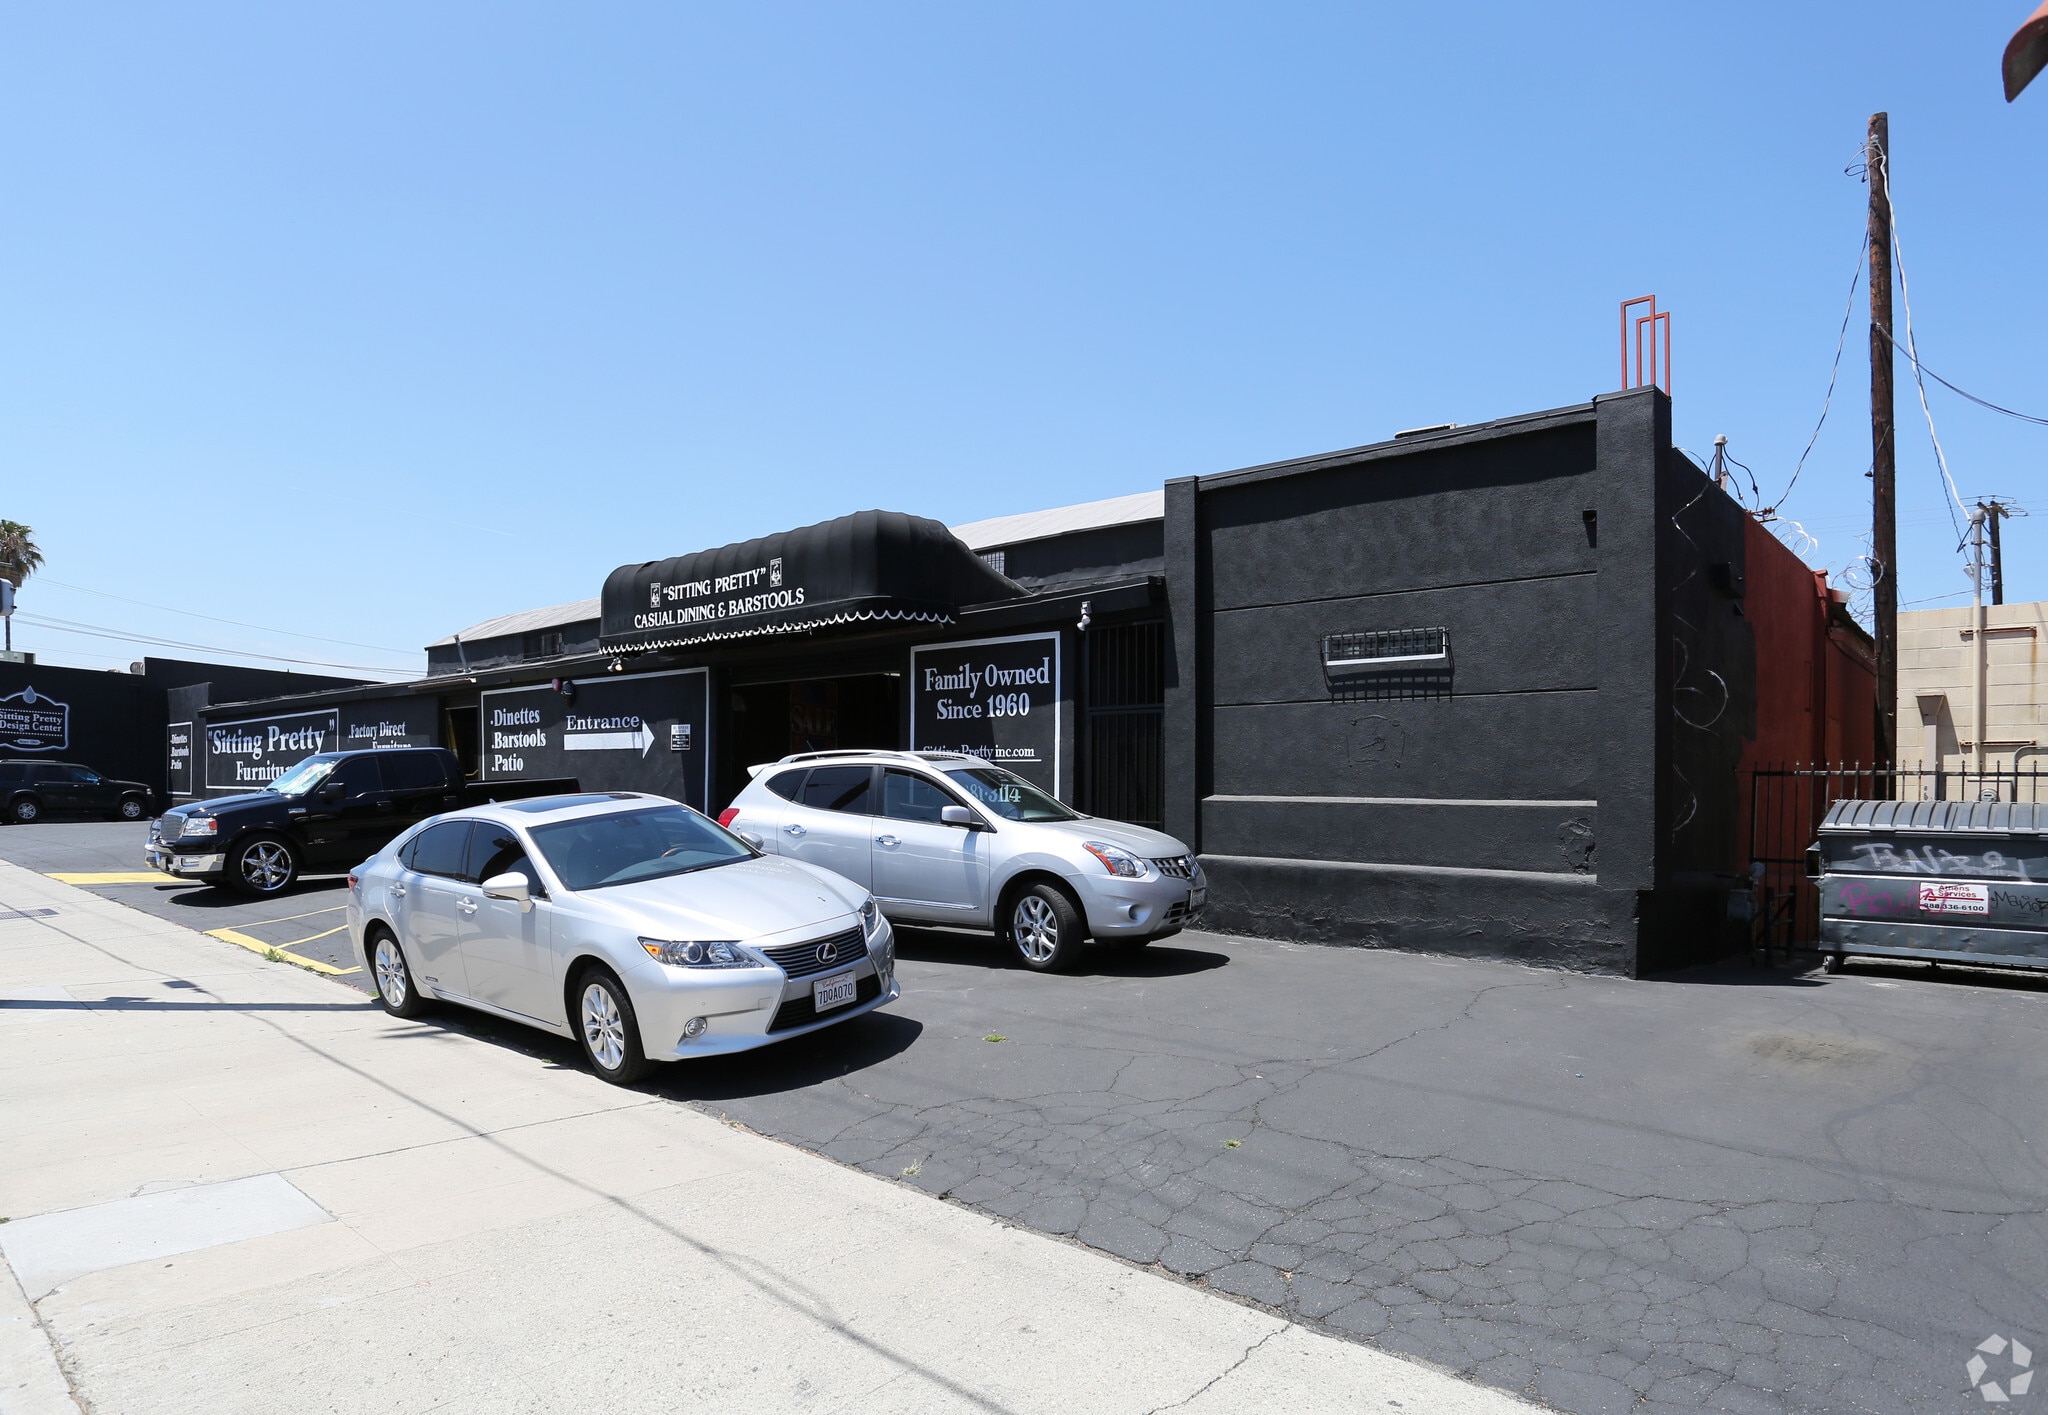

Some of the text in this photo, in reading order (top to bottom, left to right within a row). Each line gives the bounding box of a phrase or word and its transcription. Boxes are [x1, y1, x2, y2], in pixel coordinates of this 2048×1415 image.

[663, 567, 766, 601] "SITTING PRETTY"
[634, 588, 804, 629] CASUAL DINING & BARSTOOLS
[924, 657, 1050, 699] Family Owned
[937, 692, 1030, 720] Since 1960
[0, 720, 62, 732] Design Center
[33, 714, 63, 725] Pretty
[379, 721, 406, 737] Direct
[566, 715, 640, 731] Entrance
[236, 760, 293, 781] Furnitu
